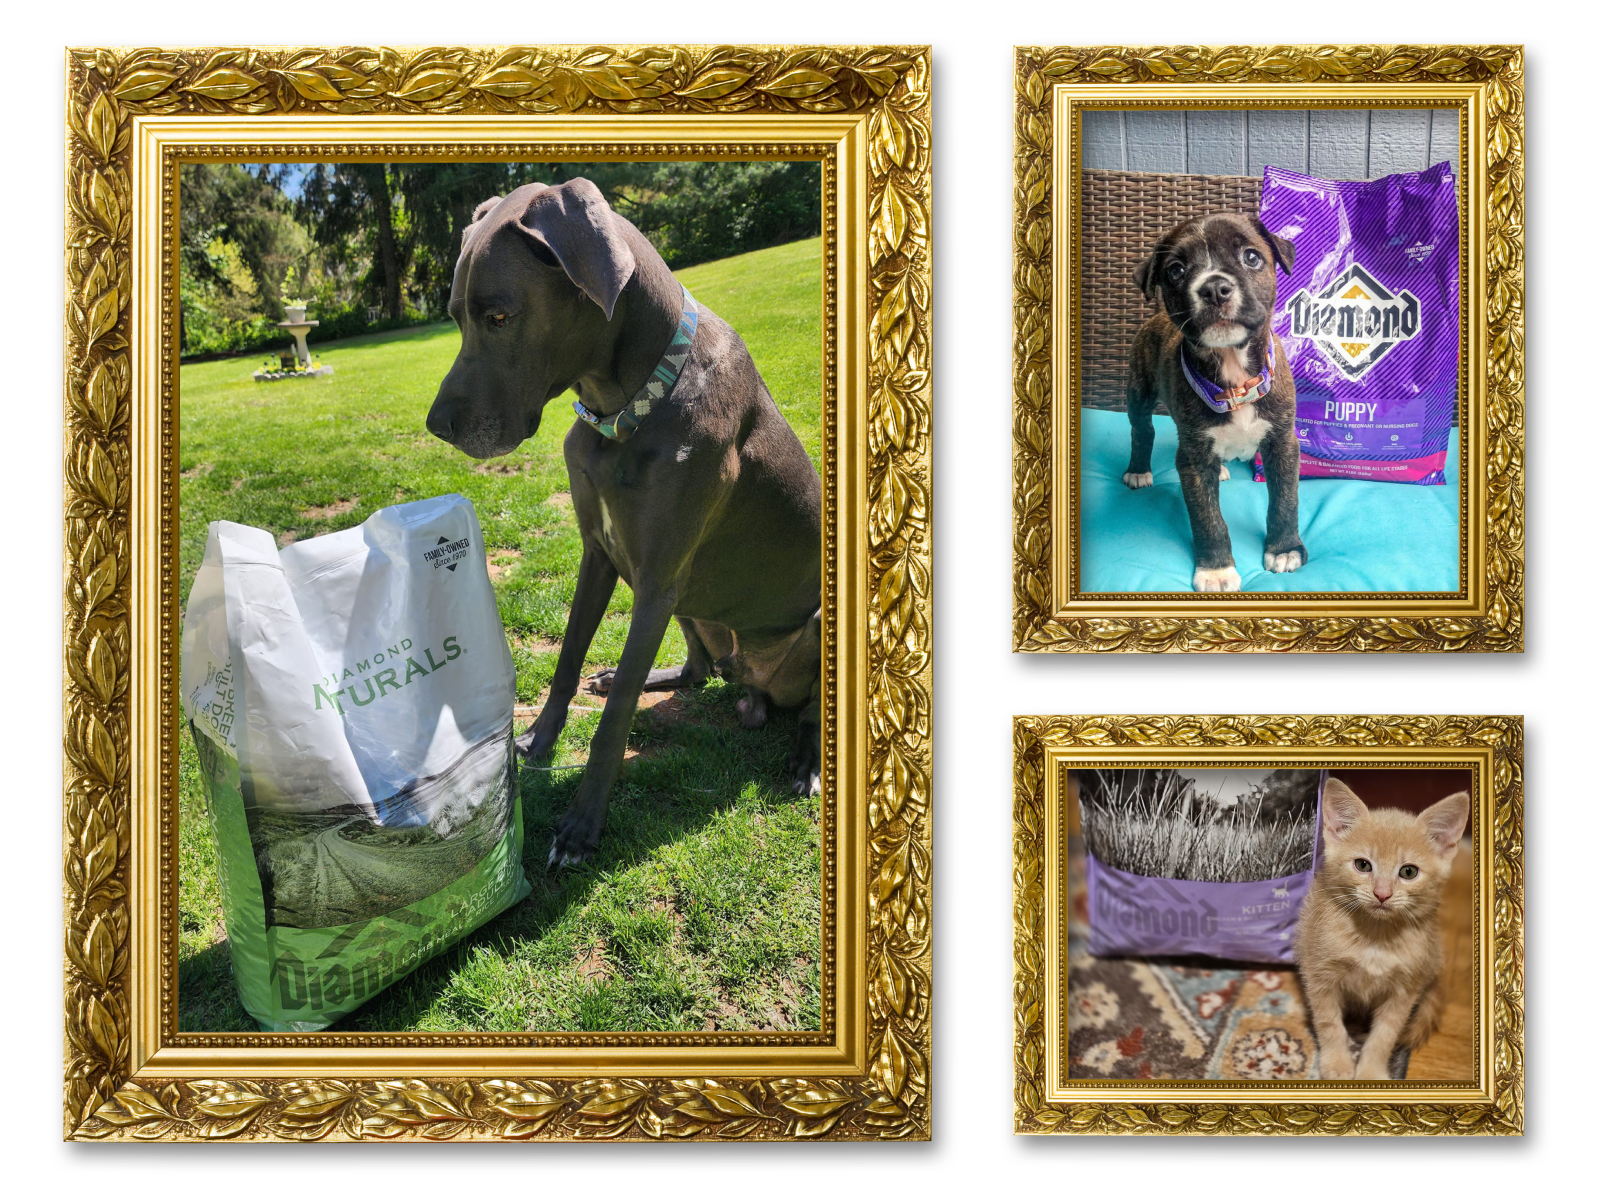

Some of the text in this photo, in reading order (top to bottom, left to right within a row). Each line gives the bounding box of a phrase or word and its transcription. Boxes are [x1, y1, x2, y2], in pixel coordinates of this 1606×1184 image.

[1287, 288, 1420, 338] Diamond
[1324, 400, 1377, 422] PUPPY
[423, 538, 470, 562] FAMILY-OWNED
[433, 549, 467, 570] Since 1970
[312, 636, 462, 716] NTURALS
[451, 876, 496, 918] LARGE
[466, 878, 506, 916] ADULT
[1242, 900, 1291, 915] KITTEN
[402, 942, 434, 965] LAMB
[436, 923, 464, 944] MEAL
[475, 898, 495, 917] RICE
